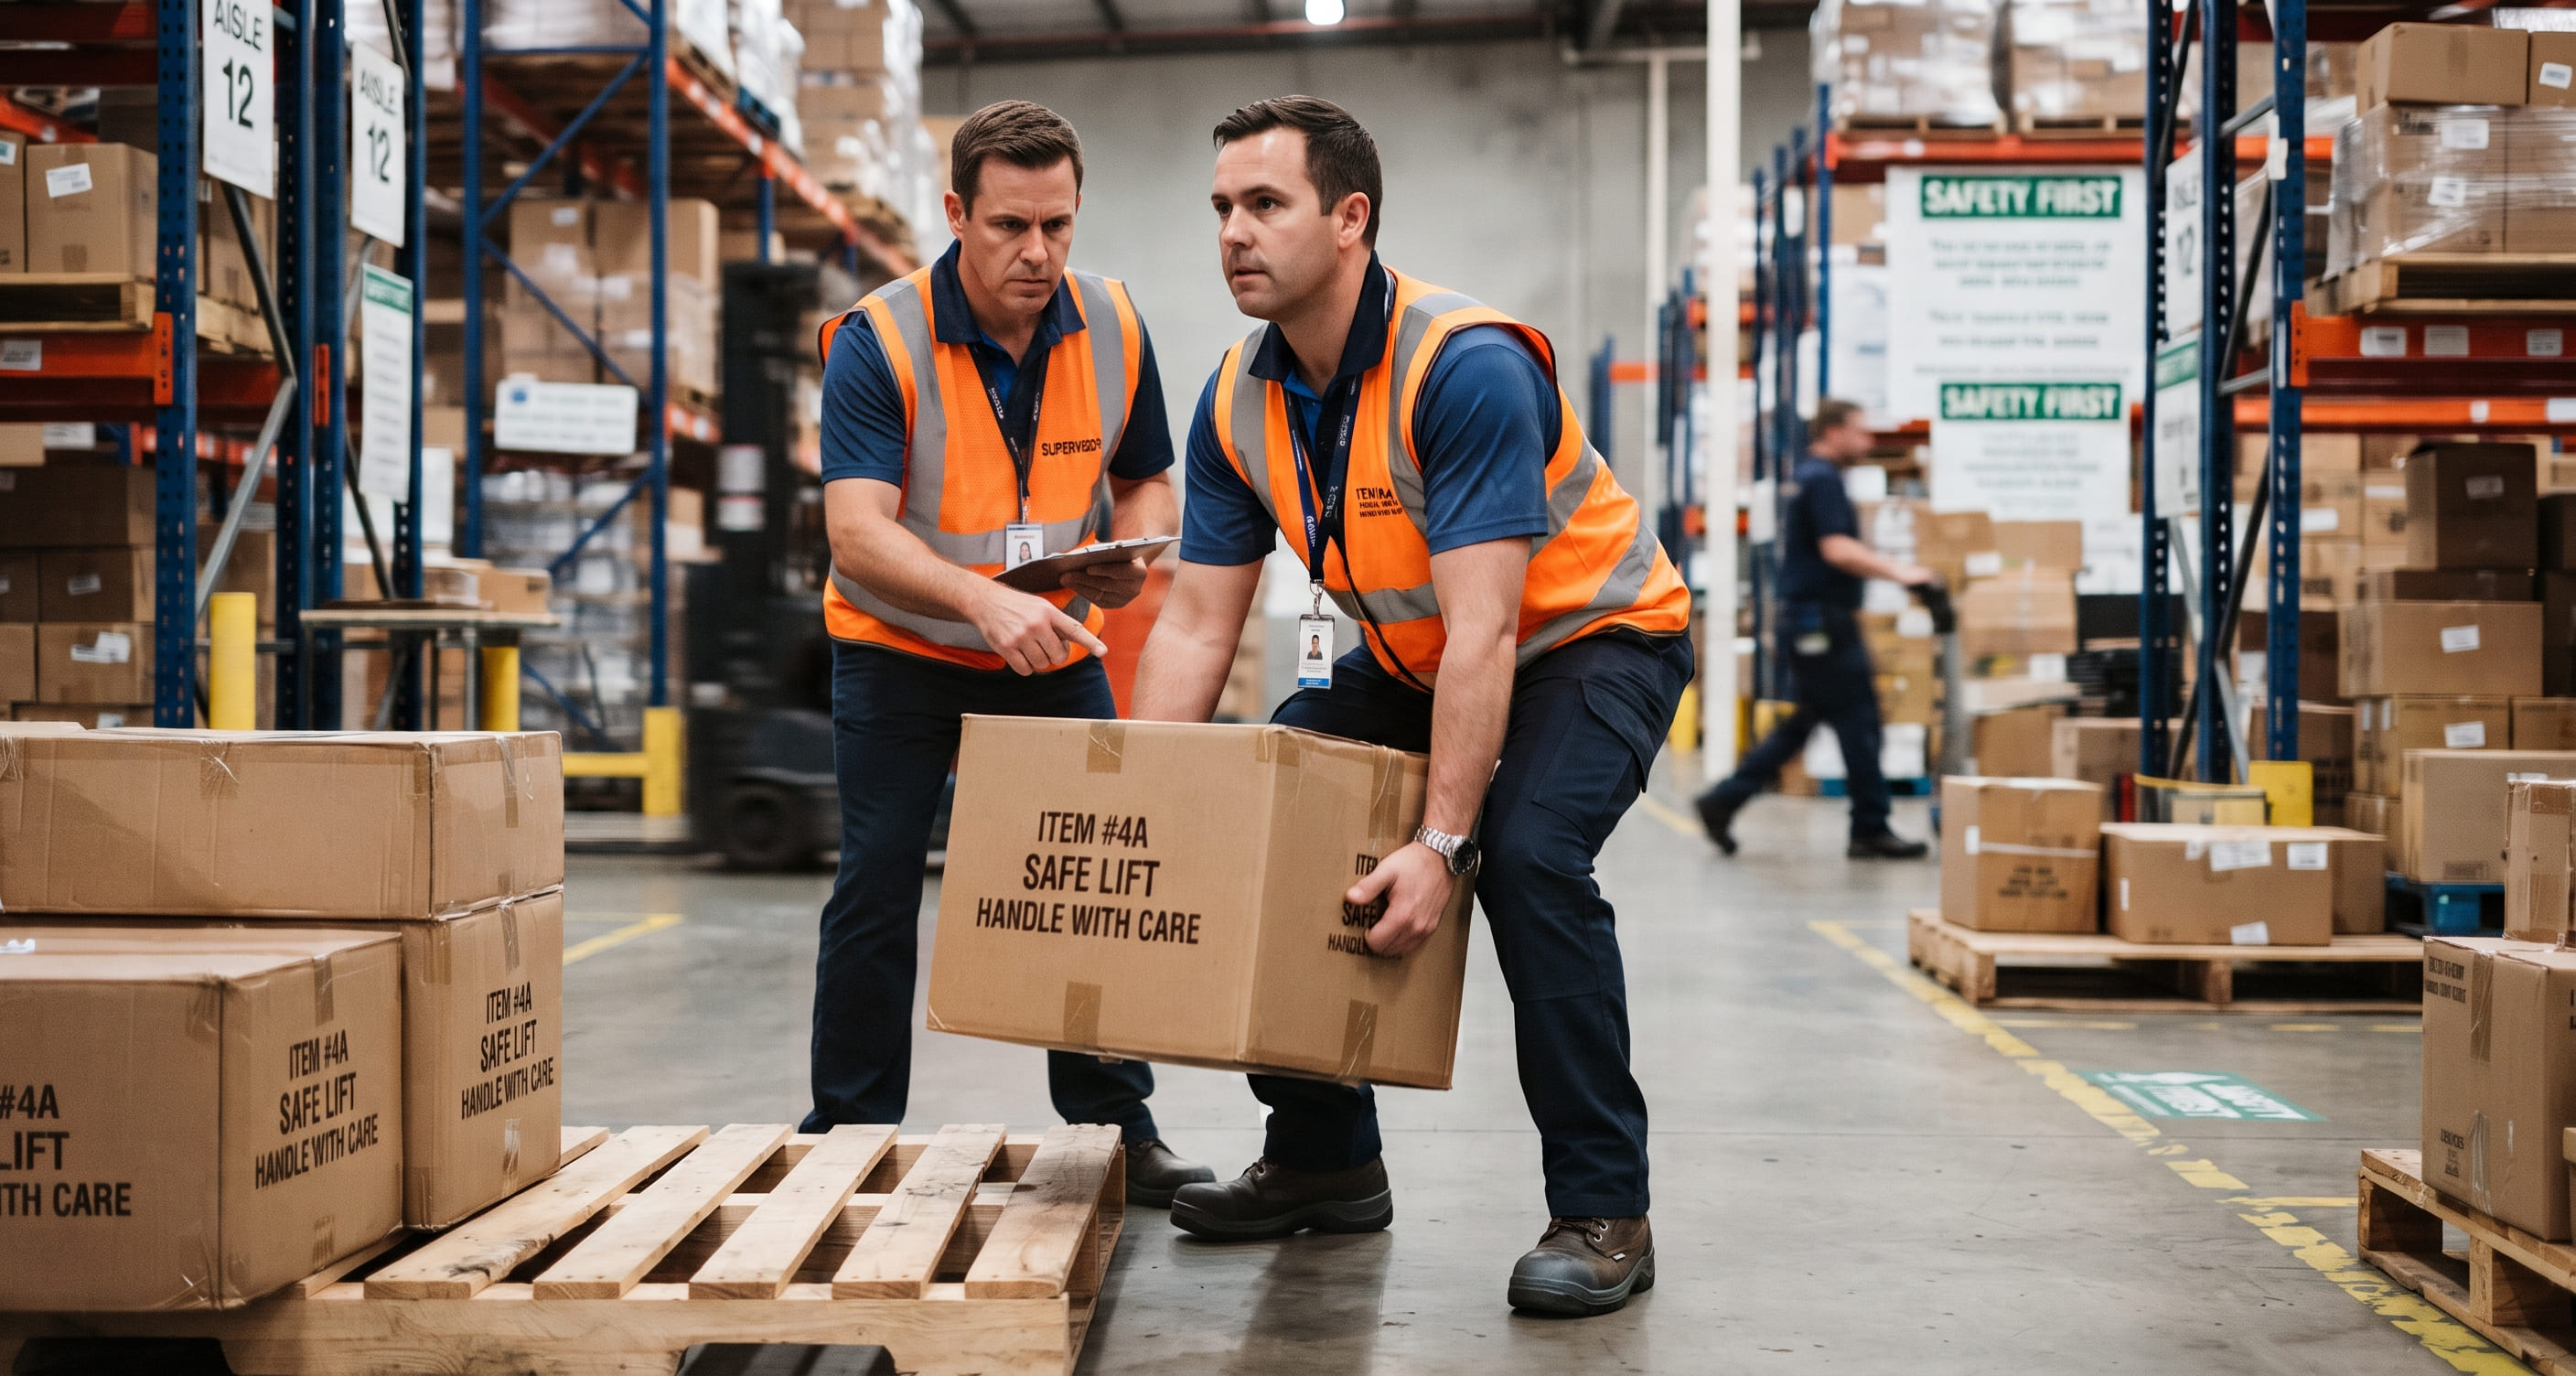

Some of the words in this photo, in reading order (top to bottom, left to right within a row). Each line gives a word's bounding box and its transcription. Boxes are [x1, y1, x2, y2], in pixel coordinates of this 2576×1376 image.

[213, 0, 262, 52] AISLE
[222, 58, 253, 129] 12
[368, 120, 390, 184] 12
[1924, 179, 2033, 215] SAFETY
[2035, 179, 2119, 215] FIRST
[1945, 385, 2039, 418] SAFETY
[2043, 385, 2118, 418] FIRST
[1037, 811, 1096, 845] ITEM
[1101, 814, 1149, 849] #4A
[1023, 853, 1090, 894] SAFE
[1099, 857, 1161, 898] LIFT
[975, 898, 1066, 936] HANDLE
[1072, 903, 1131, 941] WITH
[1138, 908, 1202, 945] CARE
[487, 987, 510, 1025] ITEM
[513, 981, 532, 1016] #4A
[289, 1037, 320, 1080] ITEM
[324, 1028, 349, 1069] #4A
[480, 1027, 510, 1073] SAFE
[514, 1018, 537, 1060] LIFT
[0, 1084, 59, 1119] #4A
[279, 1083, 320, 1135] SAFE
[326, 1071, 356, 1119] LIFT
[461, 1075, 502, 1120] HANDLE
[504, 1067, 528, 1103] WITH
[531, 1057, 553, 1092] CARE
[255, 1138, 309, 1189] HANDLE
[312, 1125, 345, 1168] WITH
[348, 1113, 378, 1155] CARE
[53, 1182, 132, 1218] CARE
